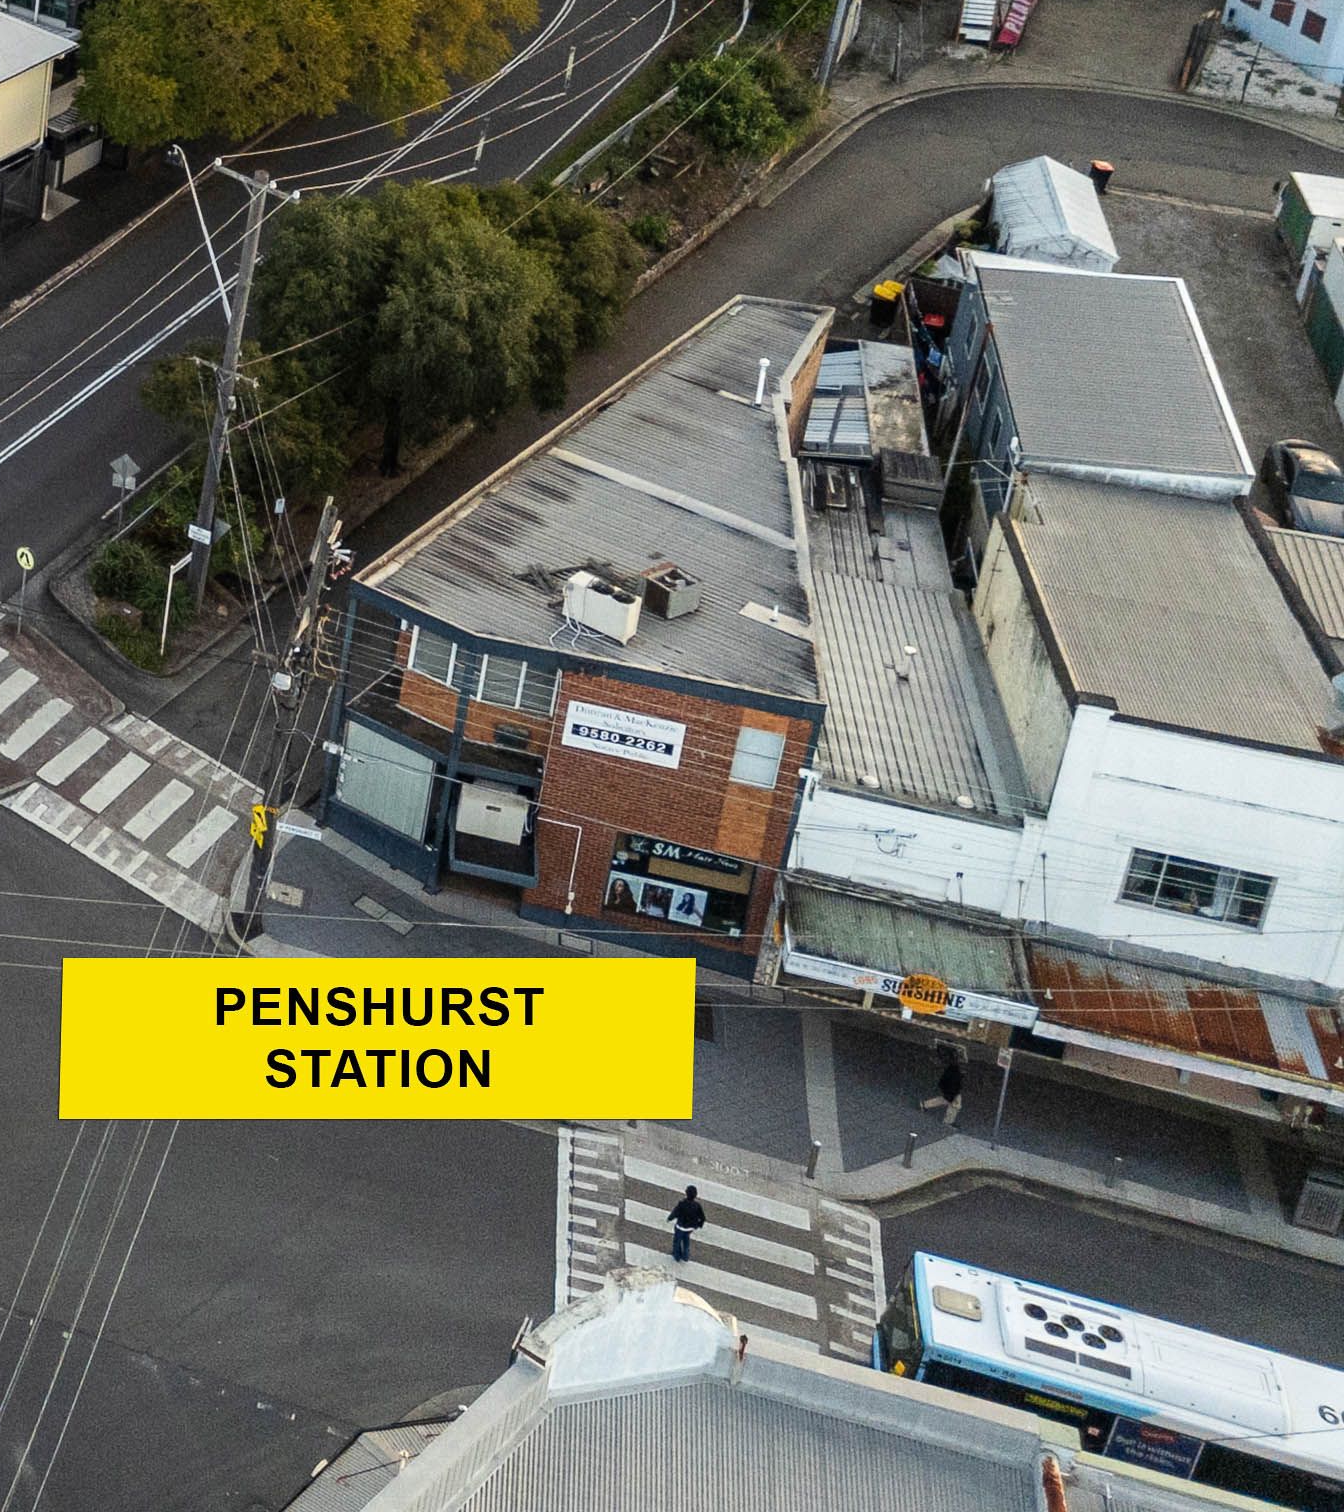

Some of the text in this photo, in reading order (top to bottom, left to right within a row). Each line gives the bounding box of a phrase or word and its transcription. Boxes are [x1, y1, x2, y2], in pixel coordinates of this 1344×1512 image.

[579, 726, 667, 754] 9580 2262
[652, 842, 682, 860] SM
[881, 977, 967, 1009] SUNSHINE
[1318, 1405, 1344, 1425] 6
